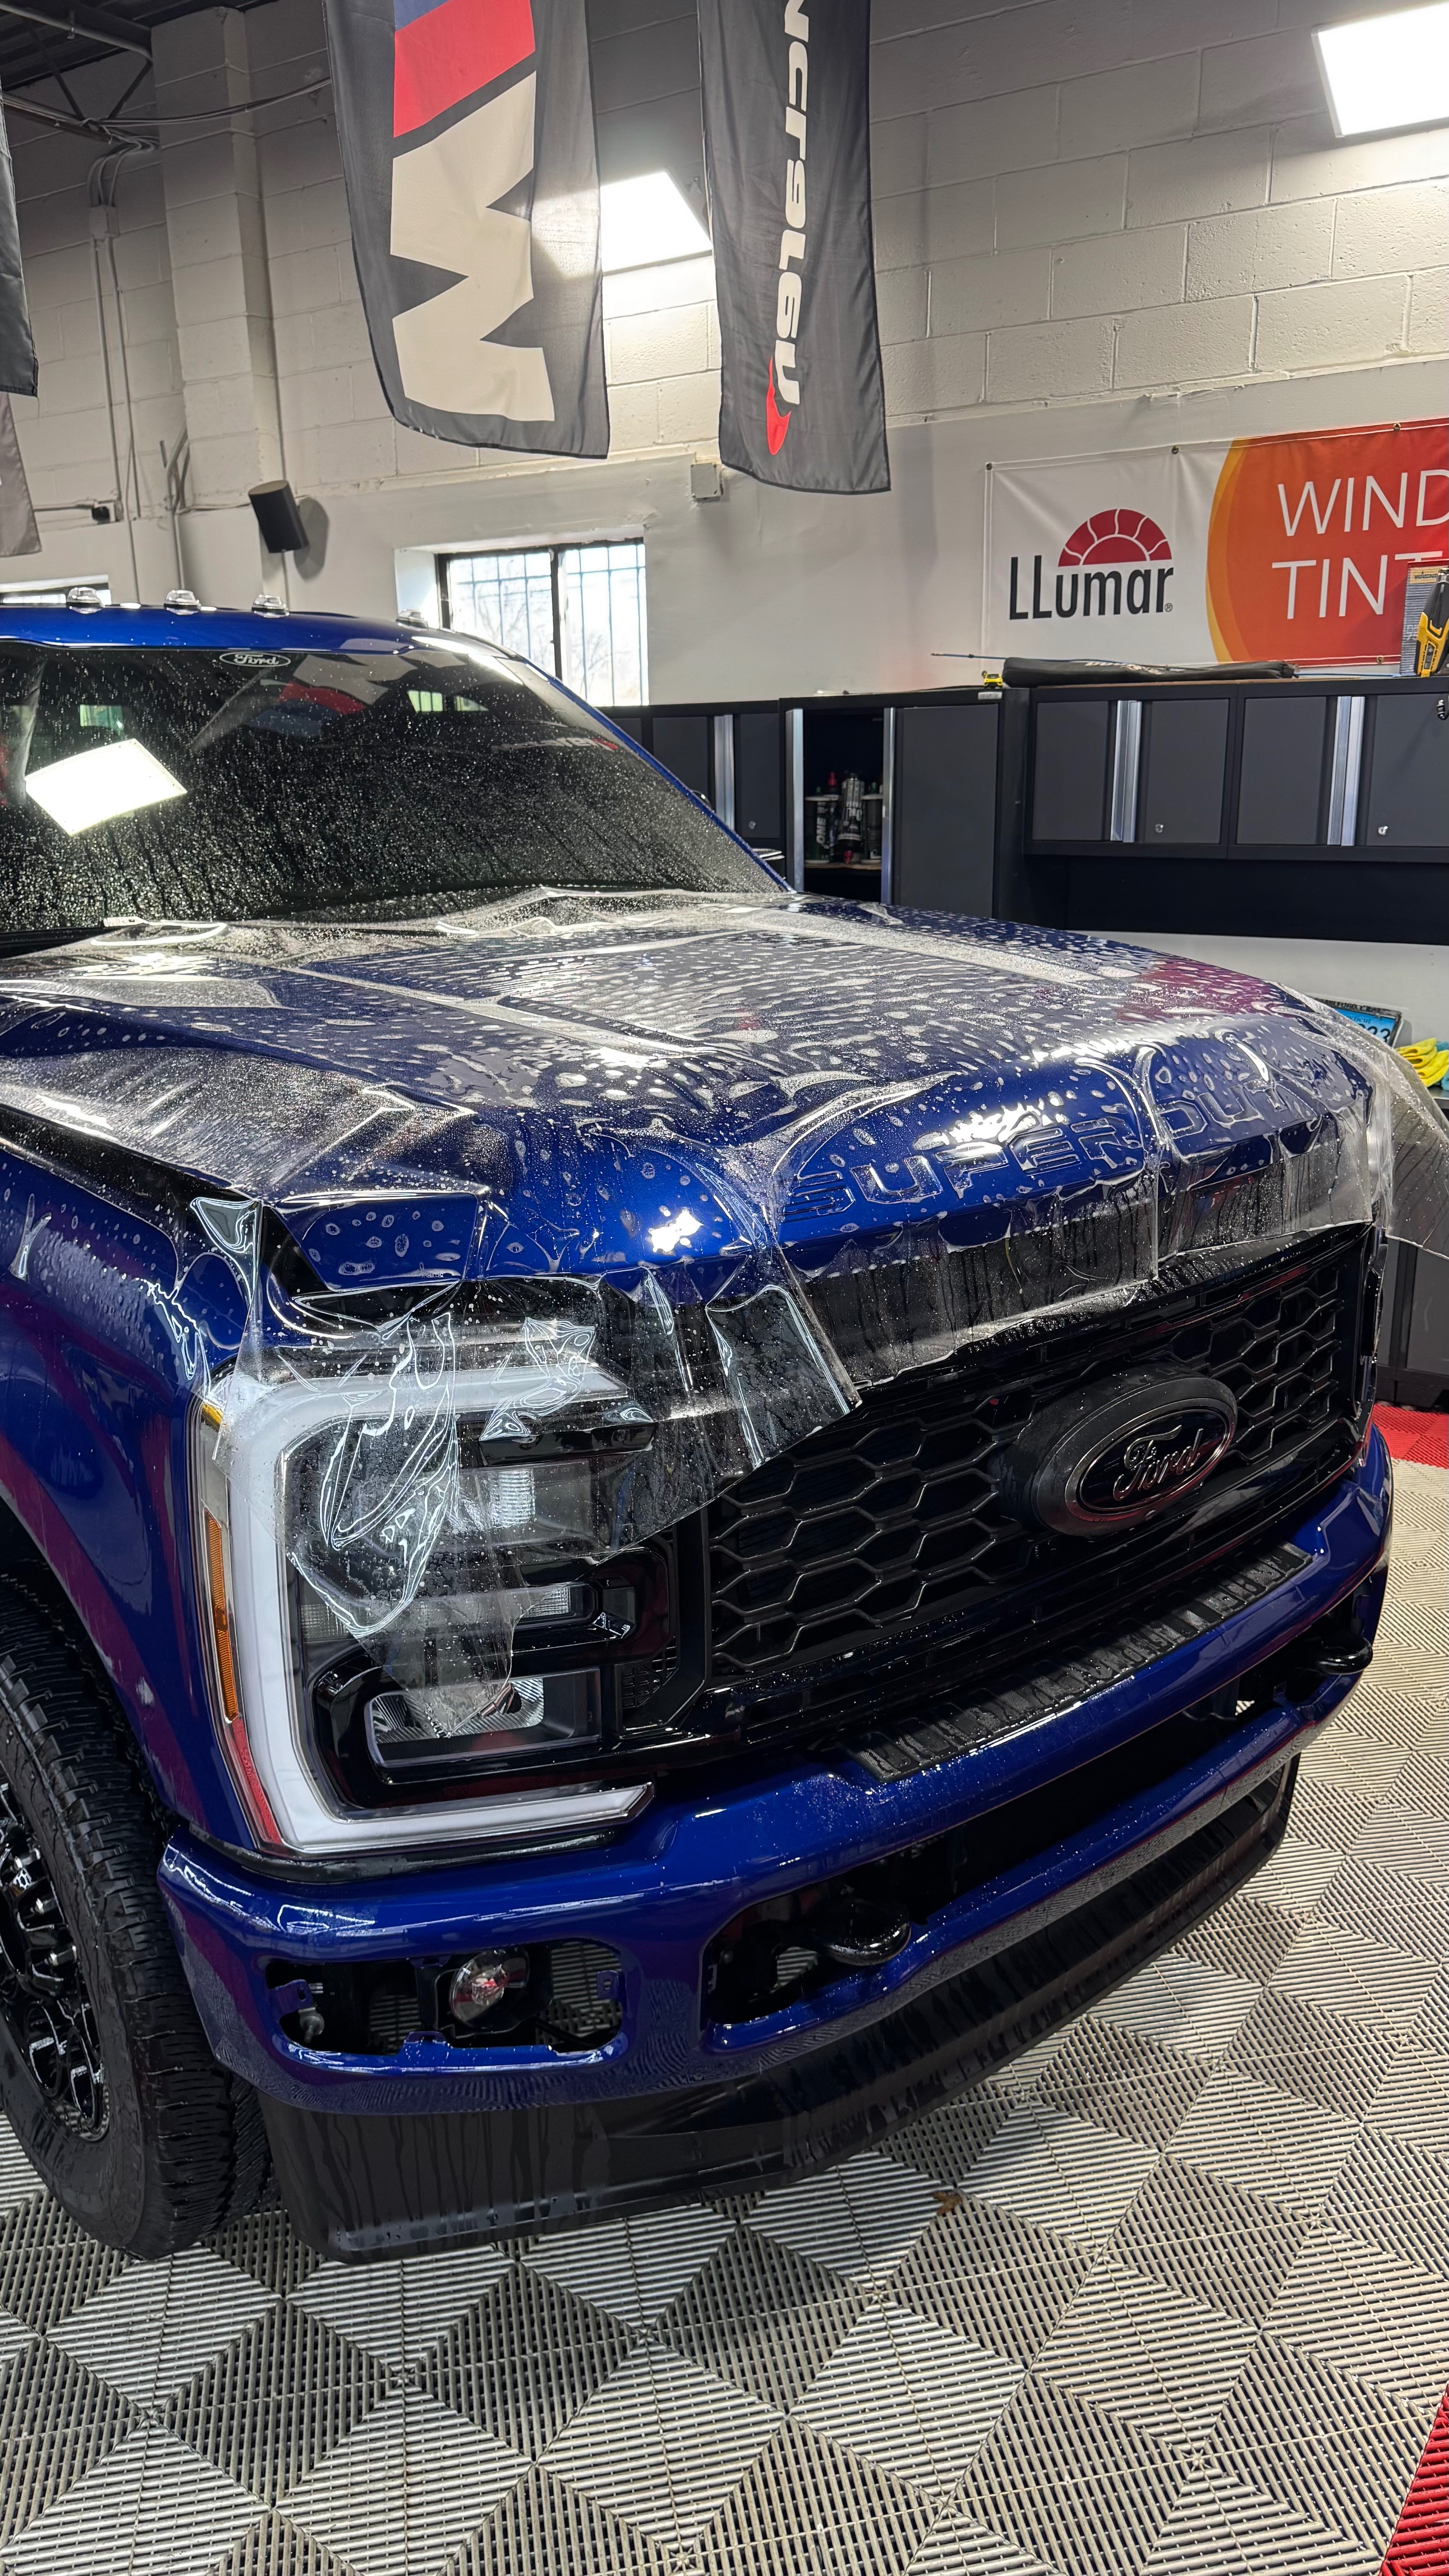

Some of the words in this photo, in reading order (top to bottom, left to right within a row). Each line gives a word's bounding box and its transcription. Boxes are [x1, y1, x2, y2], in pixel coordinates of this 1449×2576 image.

[1010, 555, 1173, 620] LLumar
[233, 654, 280, 665] Ford
[782, 1114, 1142, 1220] SUPER
[1113, 1424, 1204, 1501] Ford
